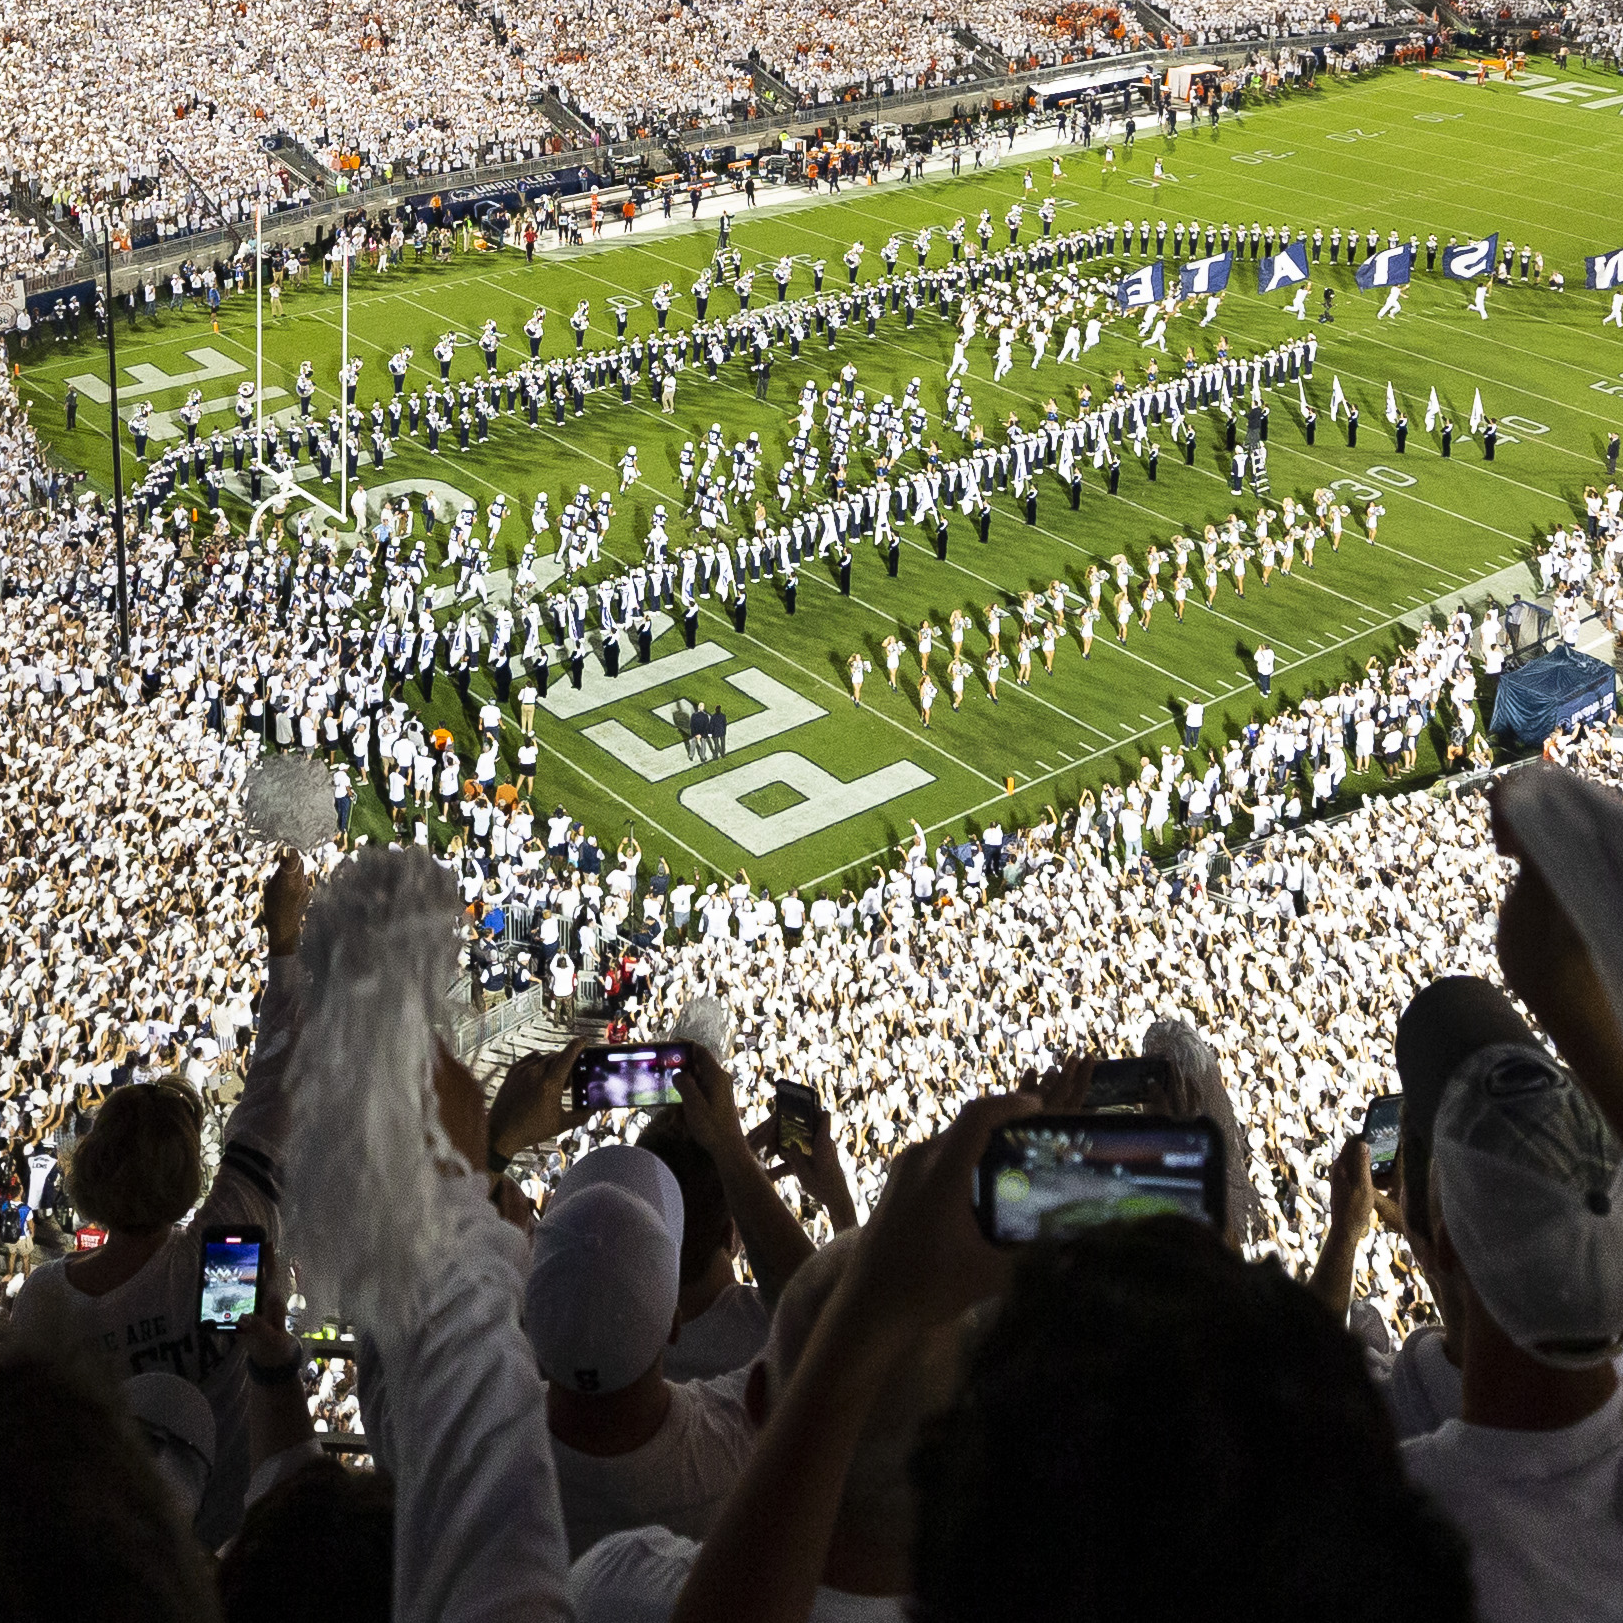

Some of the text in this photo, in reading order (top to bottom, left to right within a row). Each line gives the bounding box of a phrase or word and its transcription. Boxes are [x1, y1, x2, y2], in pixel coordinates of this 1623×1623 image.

[1230, 149, 1289, 165] 30
[1331, 465, 1418, 501] 30
[127, 1316, 167, 1345] ARE
